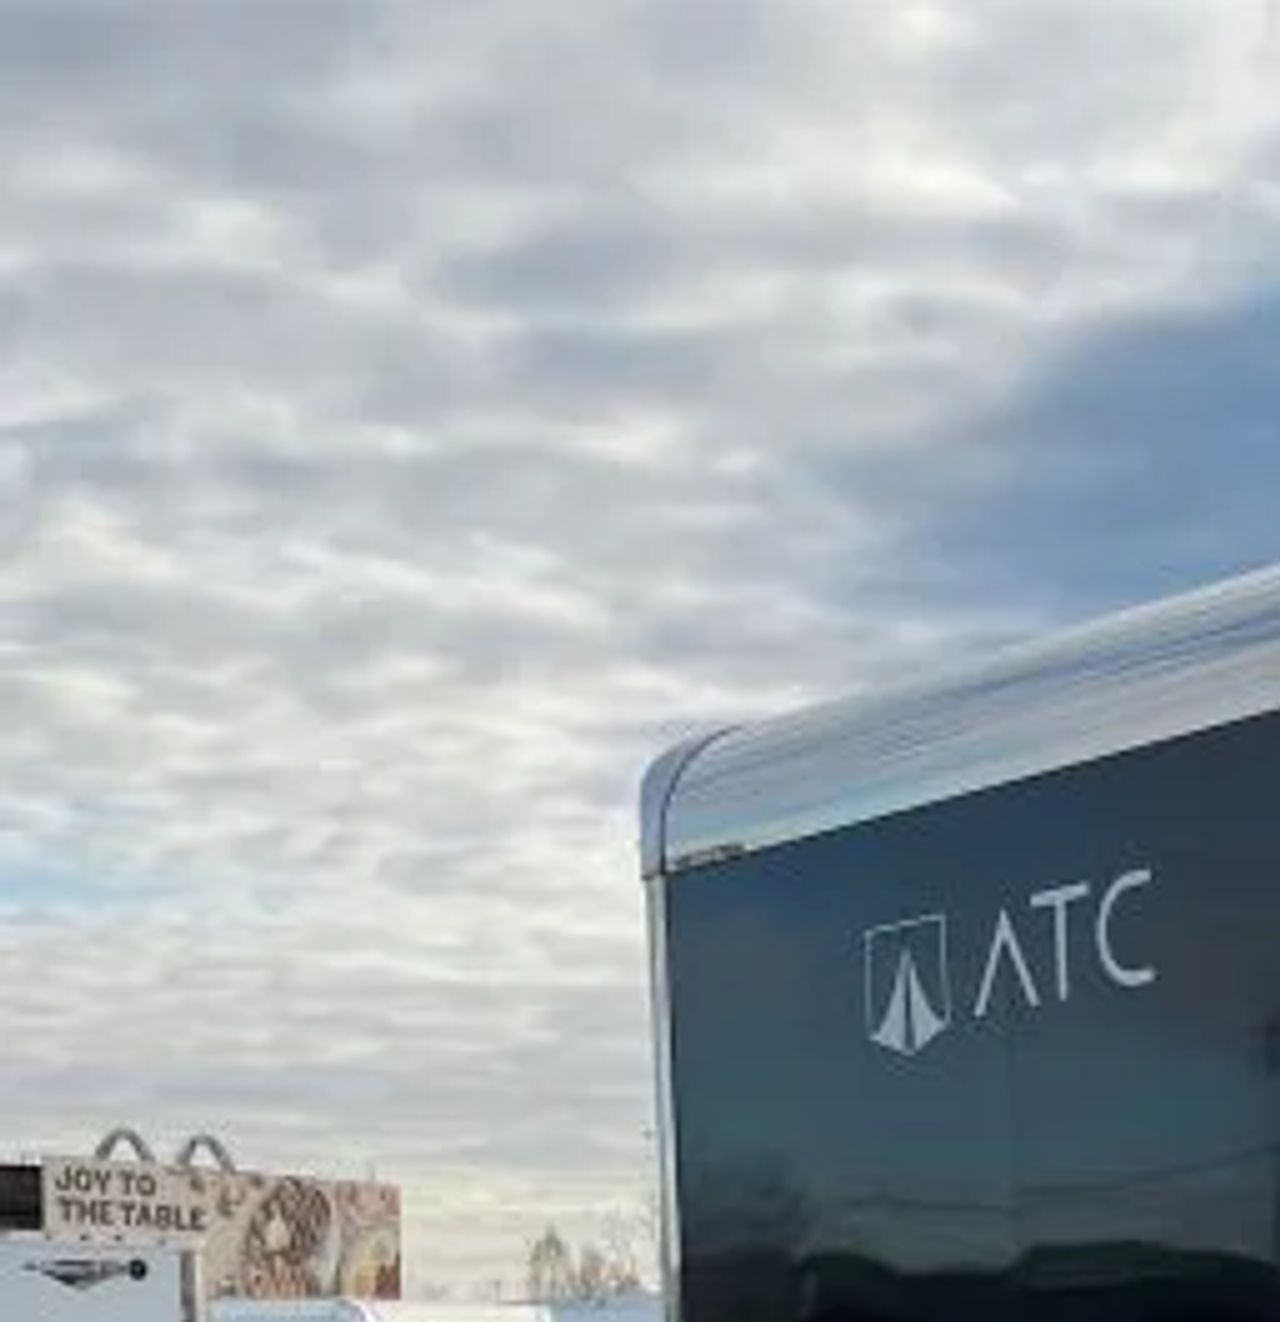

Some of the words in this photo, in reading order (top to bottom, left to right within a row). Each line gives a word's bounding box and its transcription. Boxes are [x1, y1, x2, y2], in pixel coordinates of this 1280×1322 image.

[973, 868, 1157, 1018] ATC
[55, 1166, 111, 1196] JOY
[120, 1170, 156, 1197] TO
[57, 1196, 114, 1226] THE
[121, 1201, 206, 1232] TABLE
